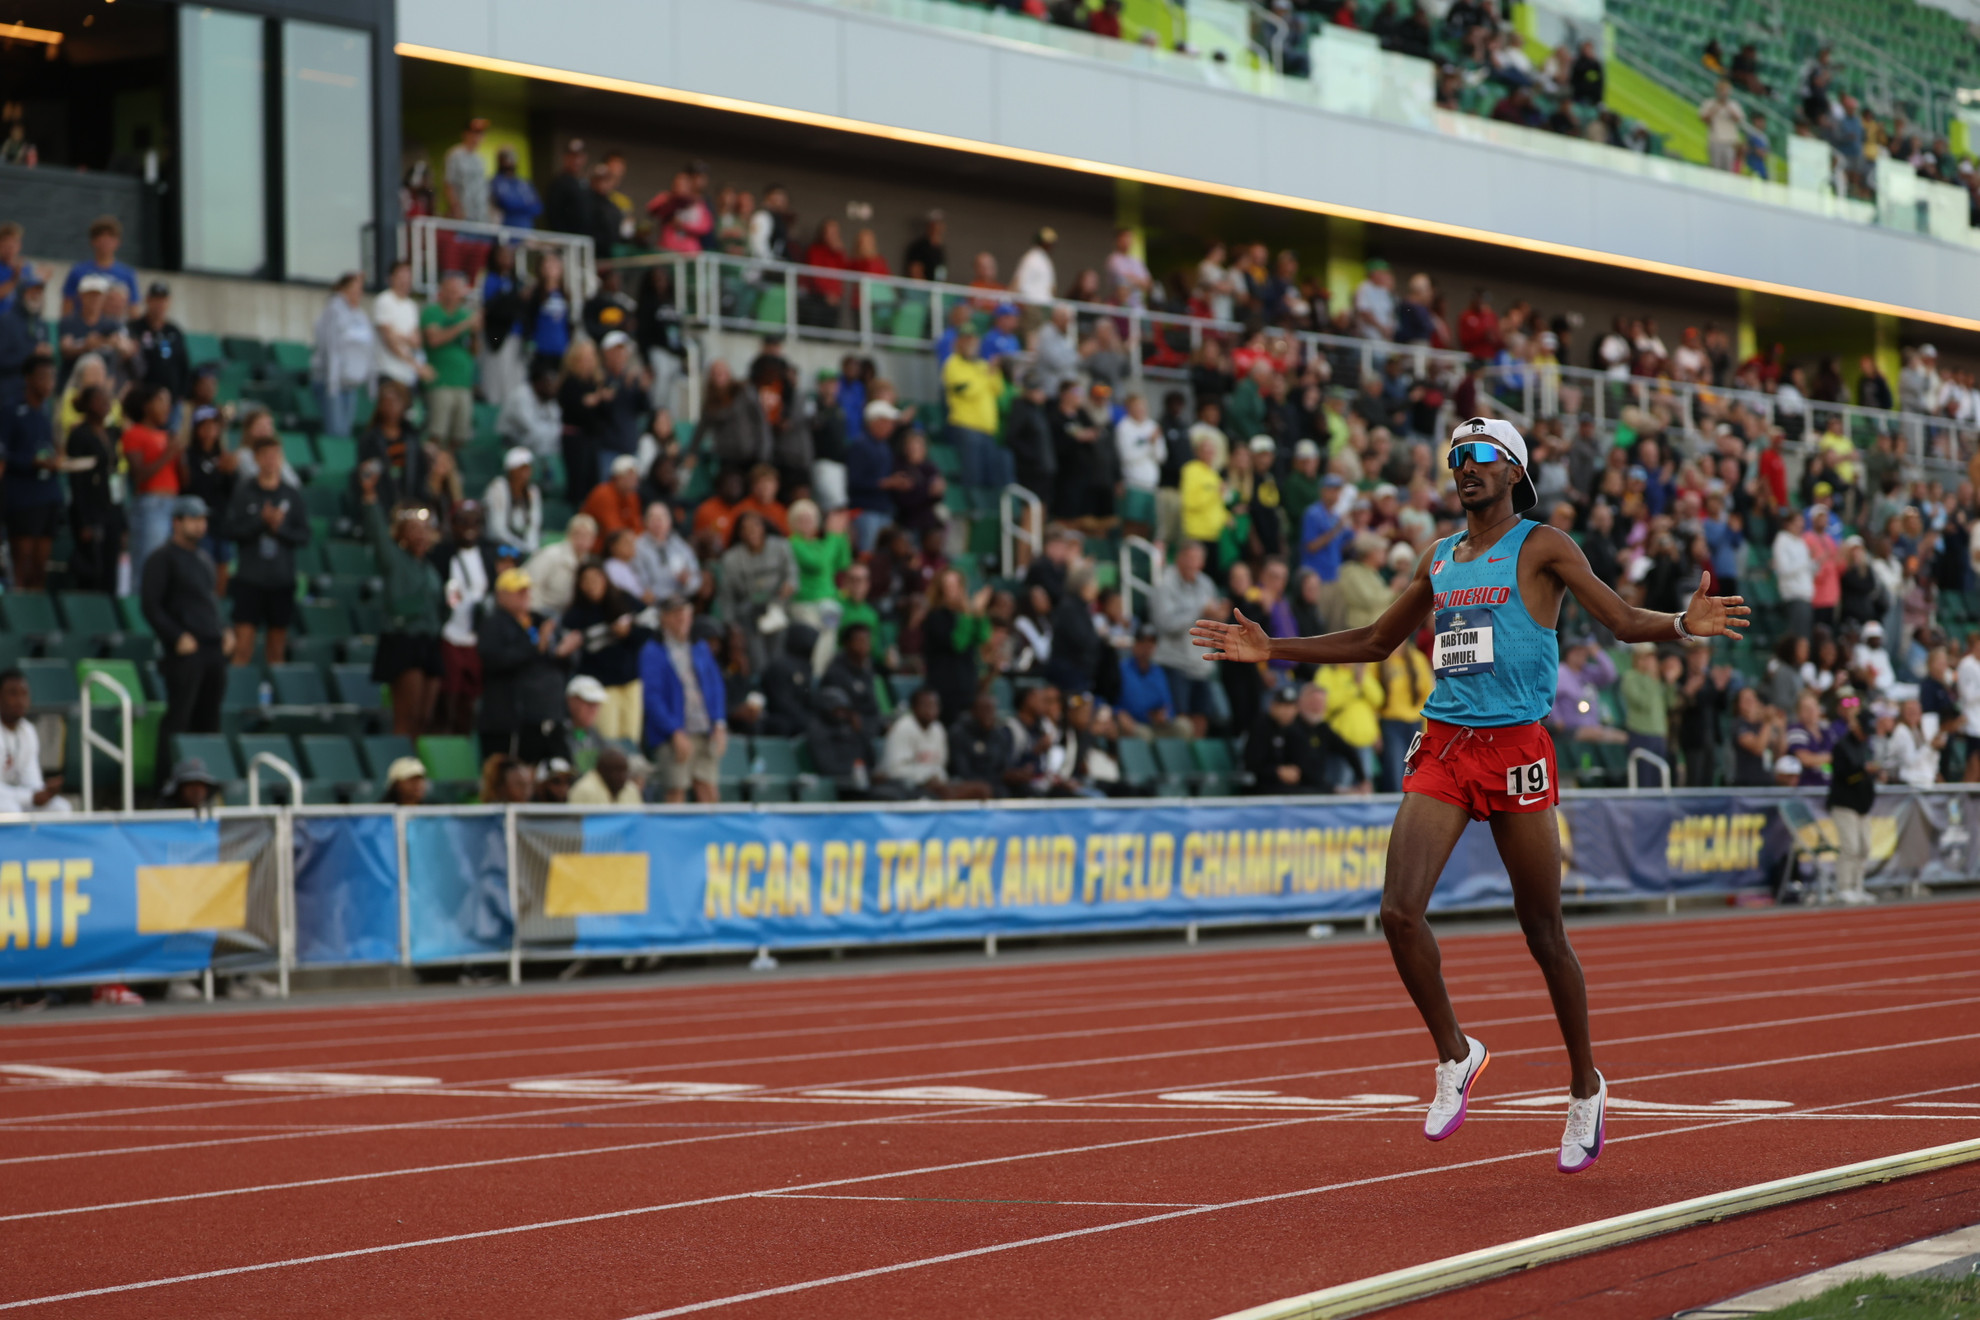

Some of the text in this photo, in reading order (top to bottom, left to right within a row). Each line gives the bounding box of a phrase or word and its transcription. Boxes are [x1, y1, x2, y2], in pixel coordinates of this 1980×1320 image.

[1448, 586, 1511, 607] MEXICO
[1441, 631, 1479, 648] HABTOM
[1442, 650, 1477, 666] SAMUEL
[1510, 763, 1544, 793] 19
[704, 825, 1393, 919] NCAA DI TRACK AND FIELD CHAMPIONSH
[0, 858, 94, 950] ATF
